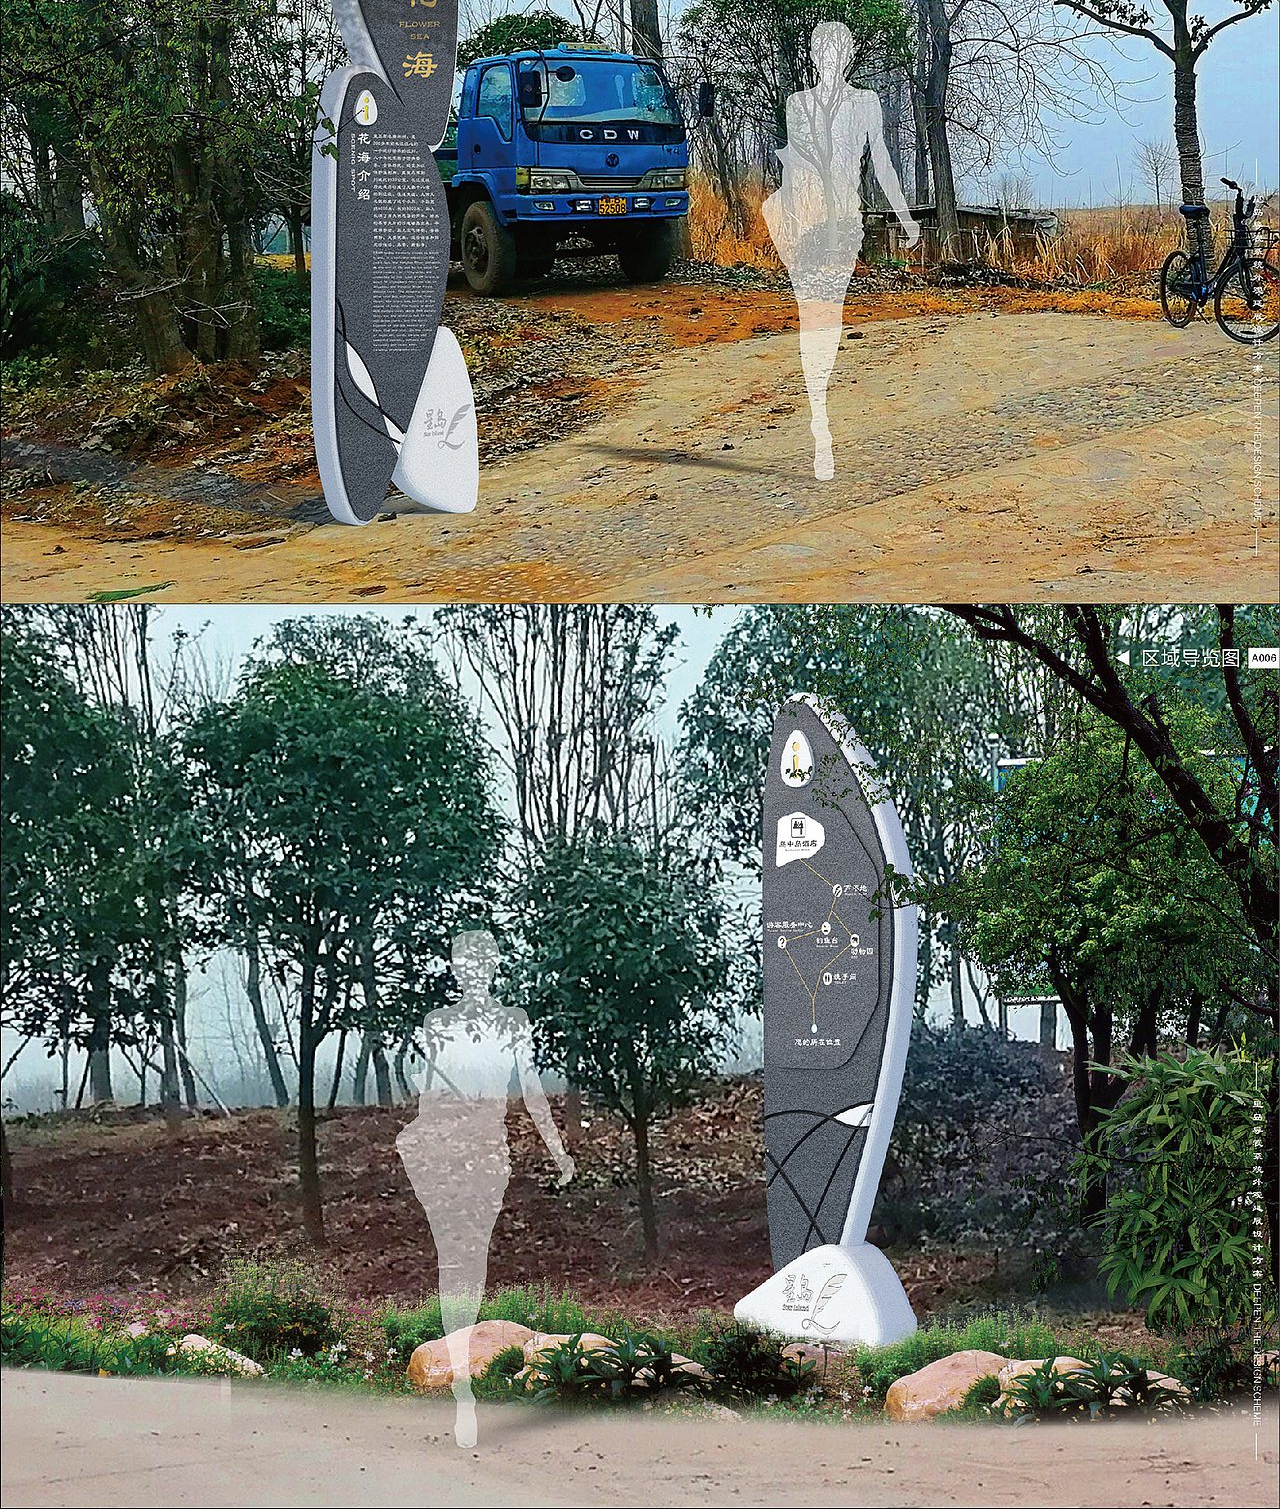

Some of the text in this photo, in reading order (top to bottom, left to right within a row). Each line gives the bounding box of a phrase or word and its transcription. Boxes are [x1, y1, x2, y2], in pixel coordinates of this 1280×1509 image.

[357, 133, 371, 201] 花海介绍
[833, 973, 857, 981] 洗手间
